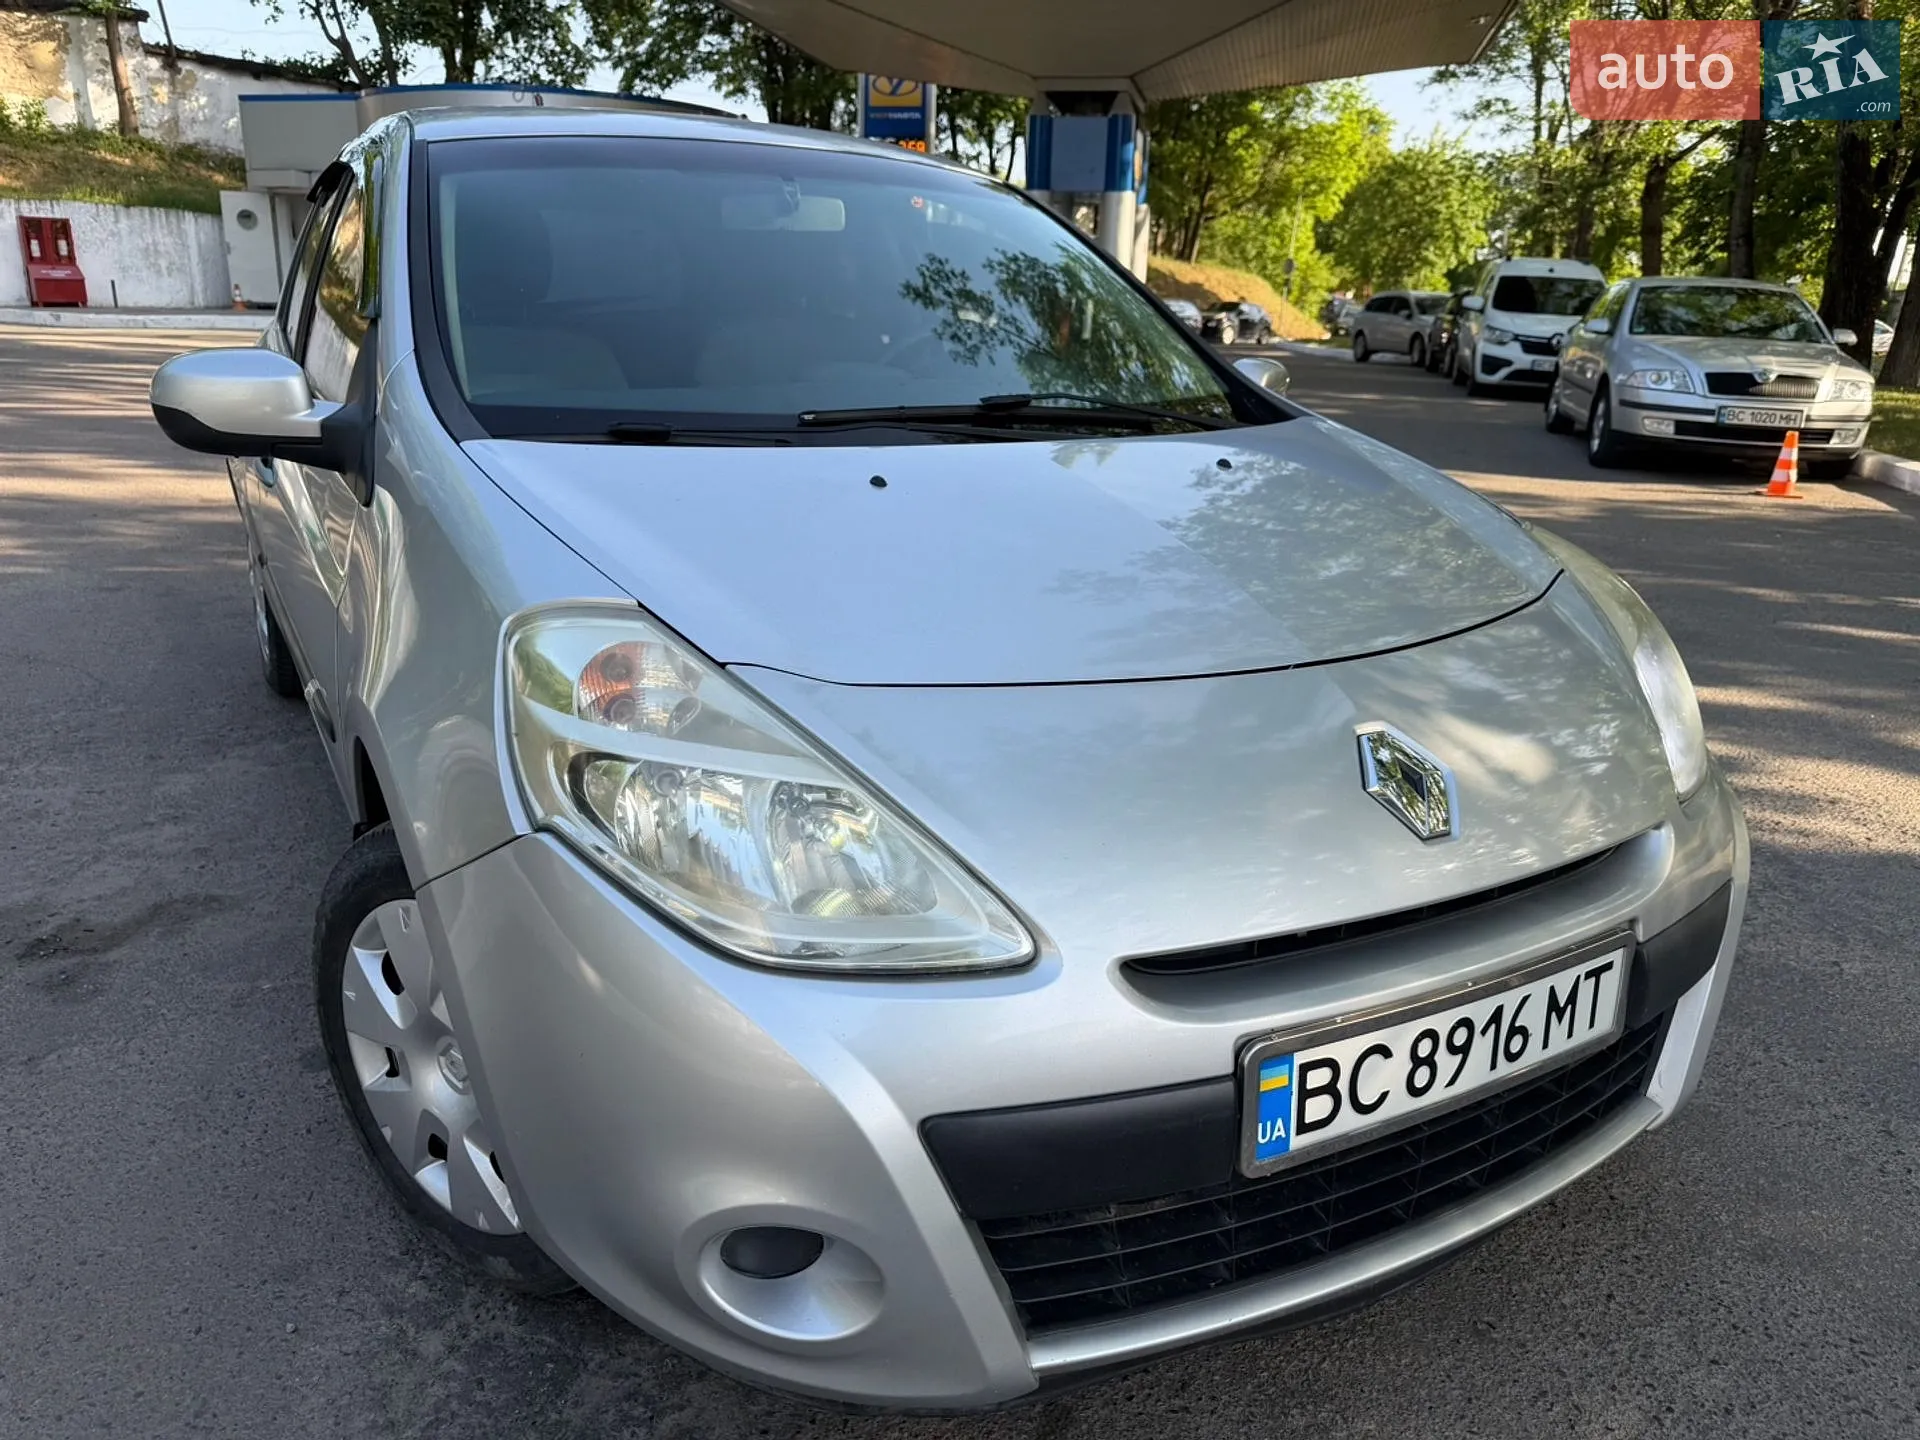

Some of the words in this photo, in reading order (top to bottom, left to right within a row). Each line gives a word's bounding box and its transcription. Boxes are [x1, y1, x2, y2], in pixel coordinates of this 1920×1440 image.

[1296, 1043, 1394, 1137] BC
[1405, 994, 1532, 1099] 8916
[1542, 960, 1614, 1051] MT
[1257, 1117, 1286, 1144] UA
